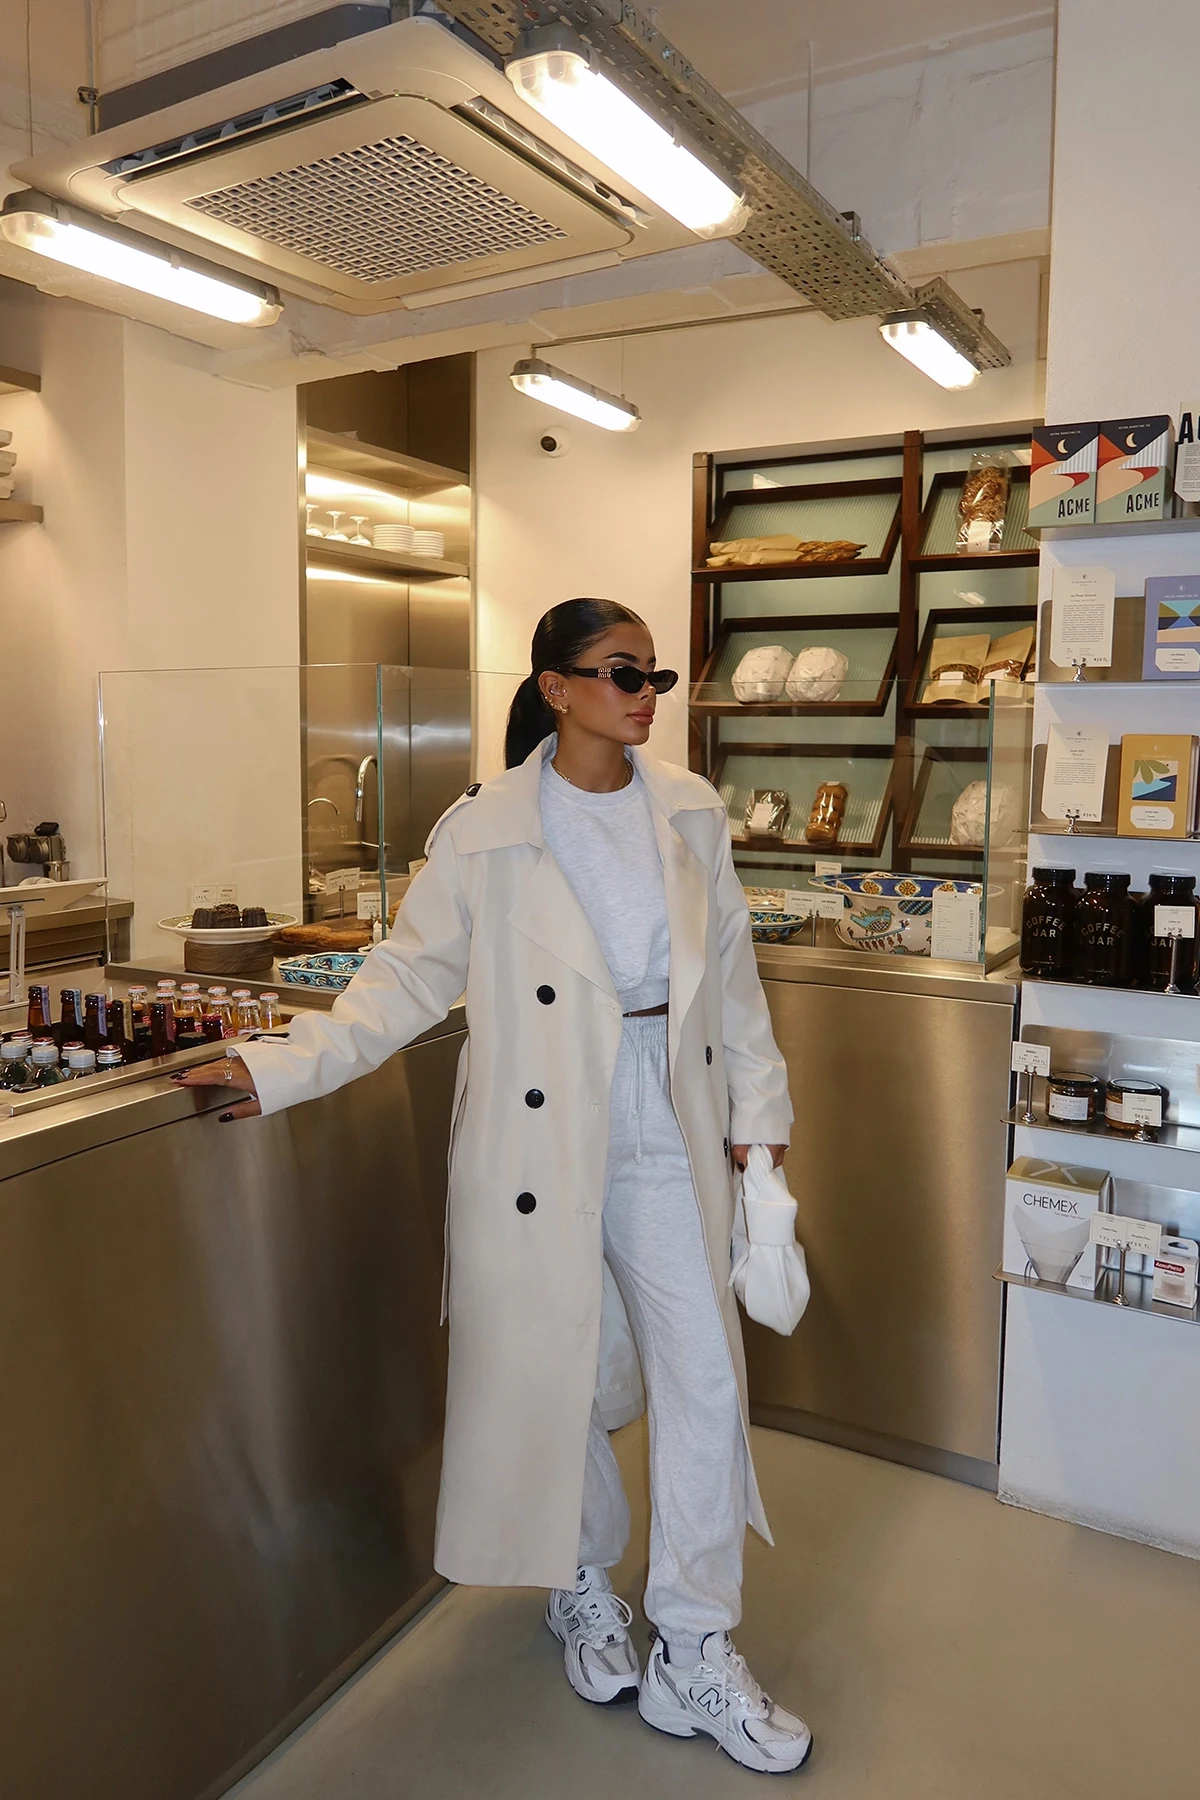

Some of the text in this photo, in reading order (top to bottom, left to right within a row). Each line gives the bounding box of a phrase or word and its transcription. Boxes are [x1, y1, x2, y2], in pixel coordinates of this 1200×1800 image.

[1178, 412, 1200, 445] A
[1058, 498, 1090, 518] ACME
[1126, 492, 1160, 513] ACME
[1026, 916, 1066, 931] COFFEE
[1033, 929, 1056, 937] JAR
[1081, 923, 1124, 938] COFFEE
[1089, 936, 1114, 945] JAR
[1023, 1193, 1078, 1214] CHEMEX
[697, 1687, 730, 1717] N
